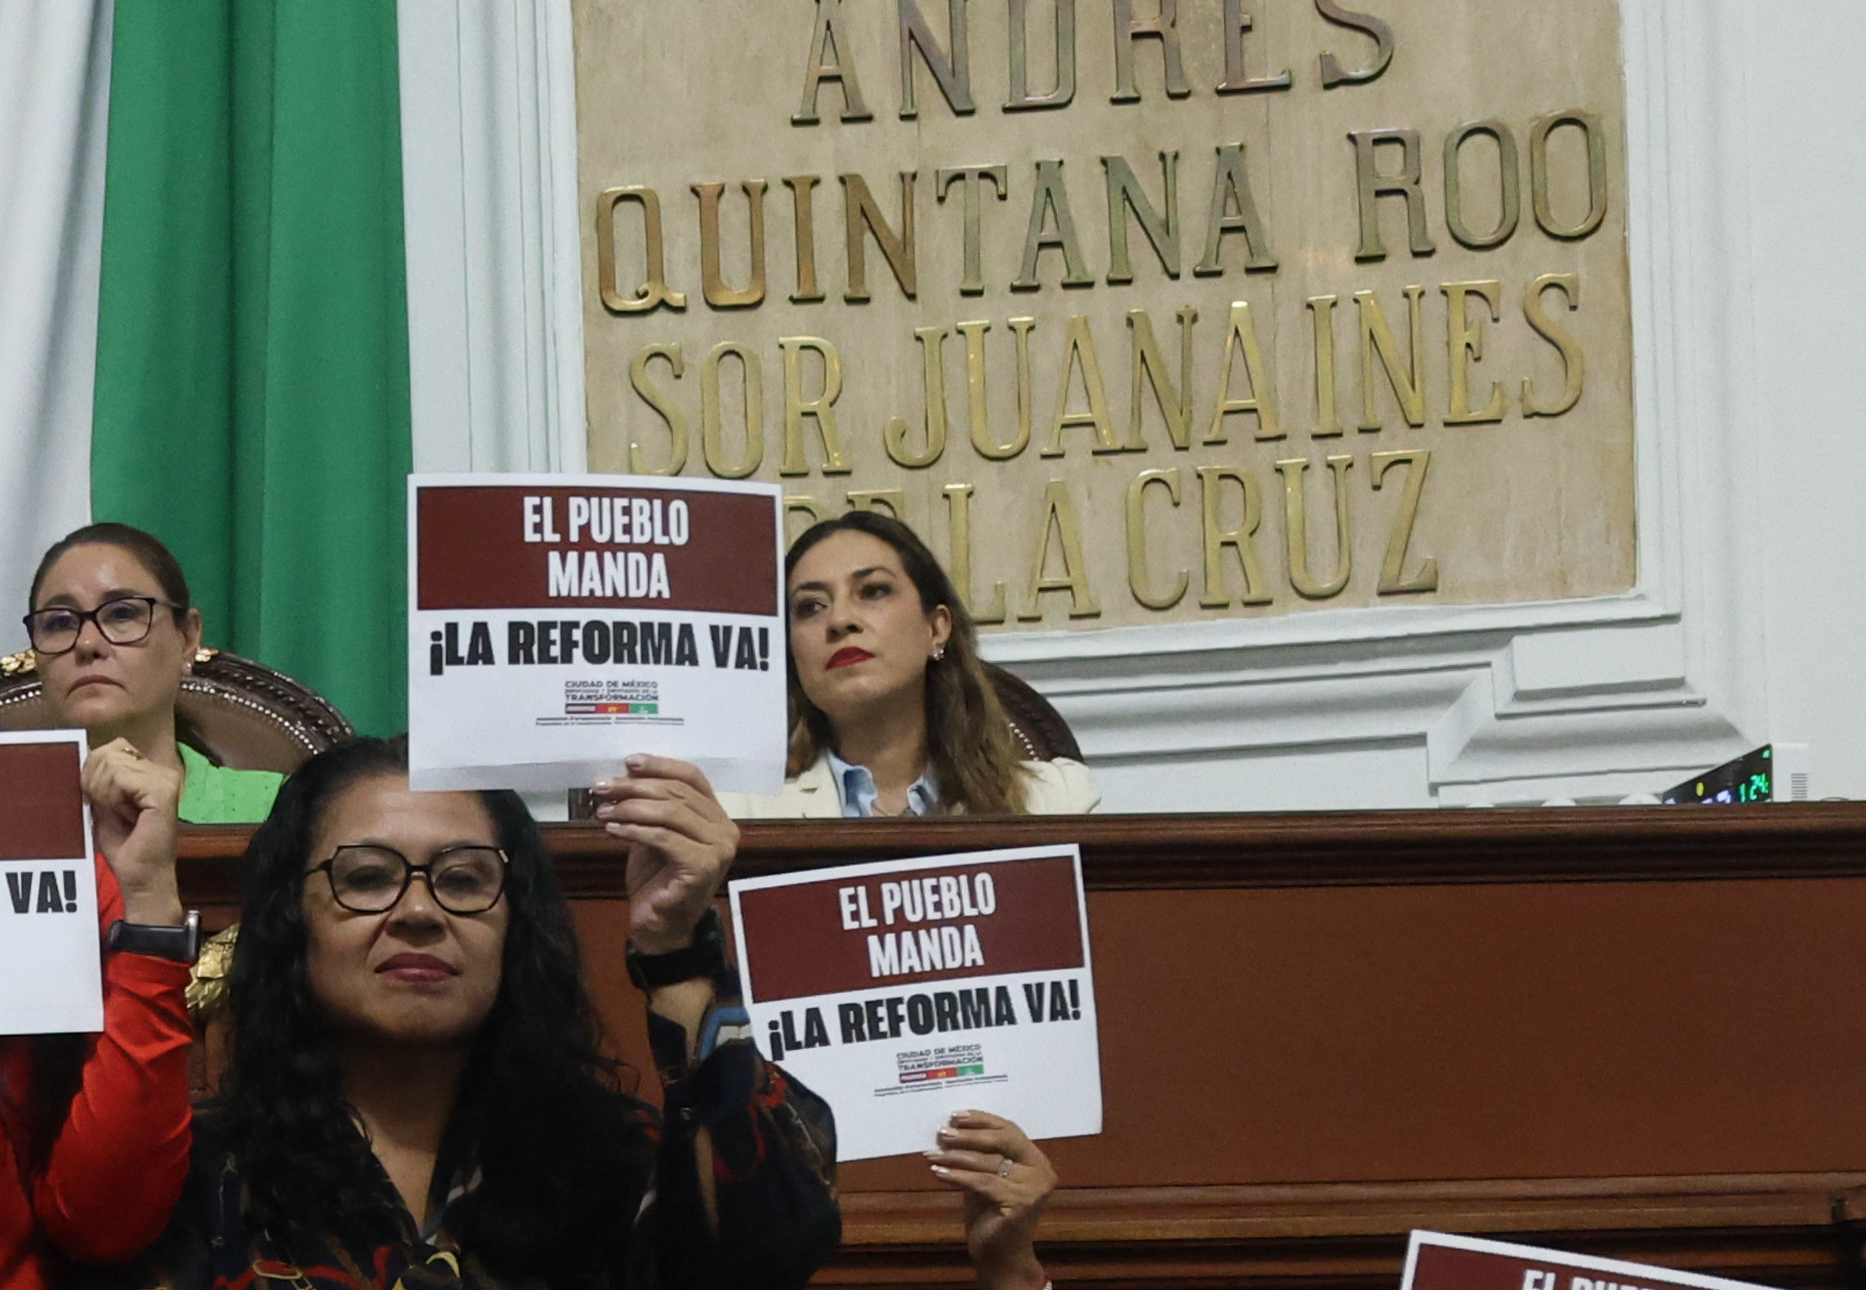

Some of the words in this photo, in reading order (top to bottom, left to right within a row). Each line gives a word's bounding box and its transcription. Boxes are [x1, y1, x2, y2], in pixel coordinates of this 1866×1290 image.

[595, 142, 1278, 313] QUINTANA
[1348, 109, 1608, 262] ROO
[628, 335, 852, 480] SOR
[524, 497, 560, 542] EL
[568, 499, 690, 547] PUEBLO
[943, 477, 1101, 623] LA
[1127, 450, 1439, 610] CRUZ
[547, 551, 670, 601] MANDA
[431, 622, 495, 675] ¡LA
[508, 620, 698, 666] REFORMA
[710, 625, 768, 671] VA!
[6, 871, 77, 913] VA!
[839, 886, 877, 929] EL
[881, 873, 995, 924] PUEBLO
[868, 925, 984, 977] MANDA
[769, 1007, 830, 1061] ¡LA
[838, 986, 1016, 1044] REFORMA
[1023, 980, 1080, 1023] VA!
